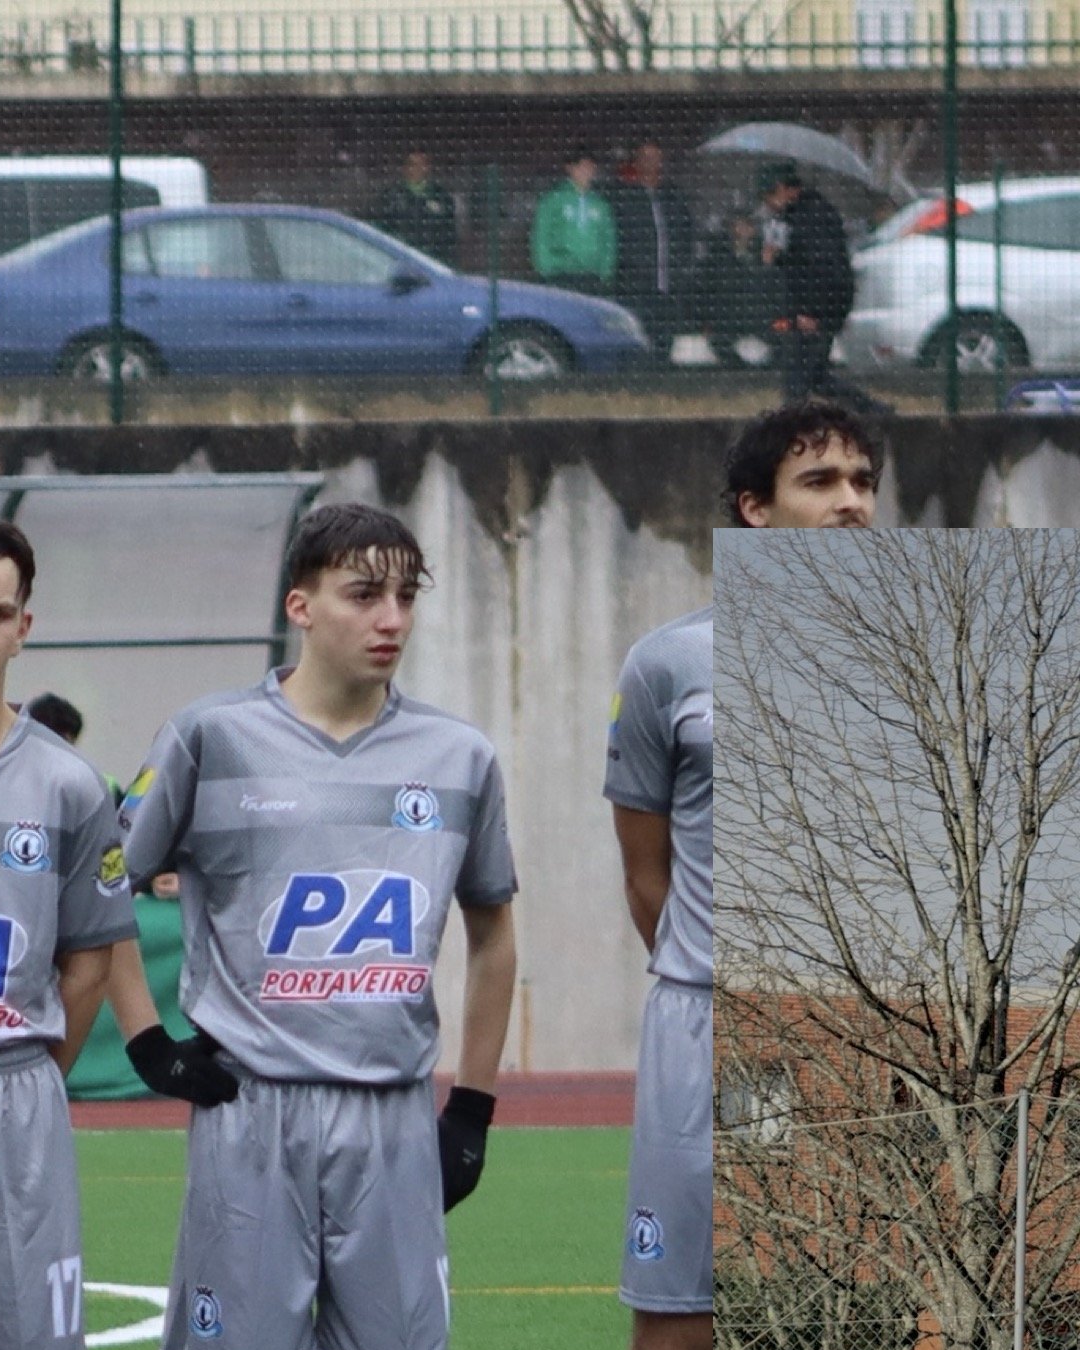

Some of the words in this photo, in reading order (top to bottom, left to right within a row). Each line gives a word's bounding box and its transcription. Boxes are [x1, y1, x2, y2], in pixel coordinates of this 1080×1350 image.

[265, 874, 414, 957] PA
[262, 966, 428, 1000] PORTAVEIRO
[47, 1256, 81, 1338] 17
